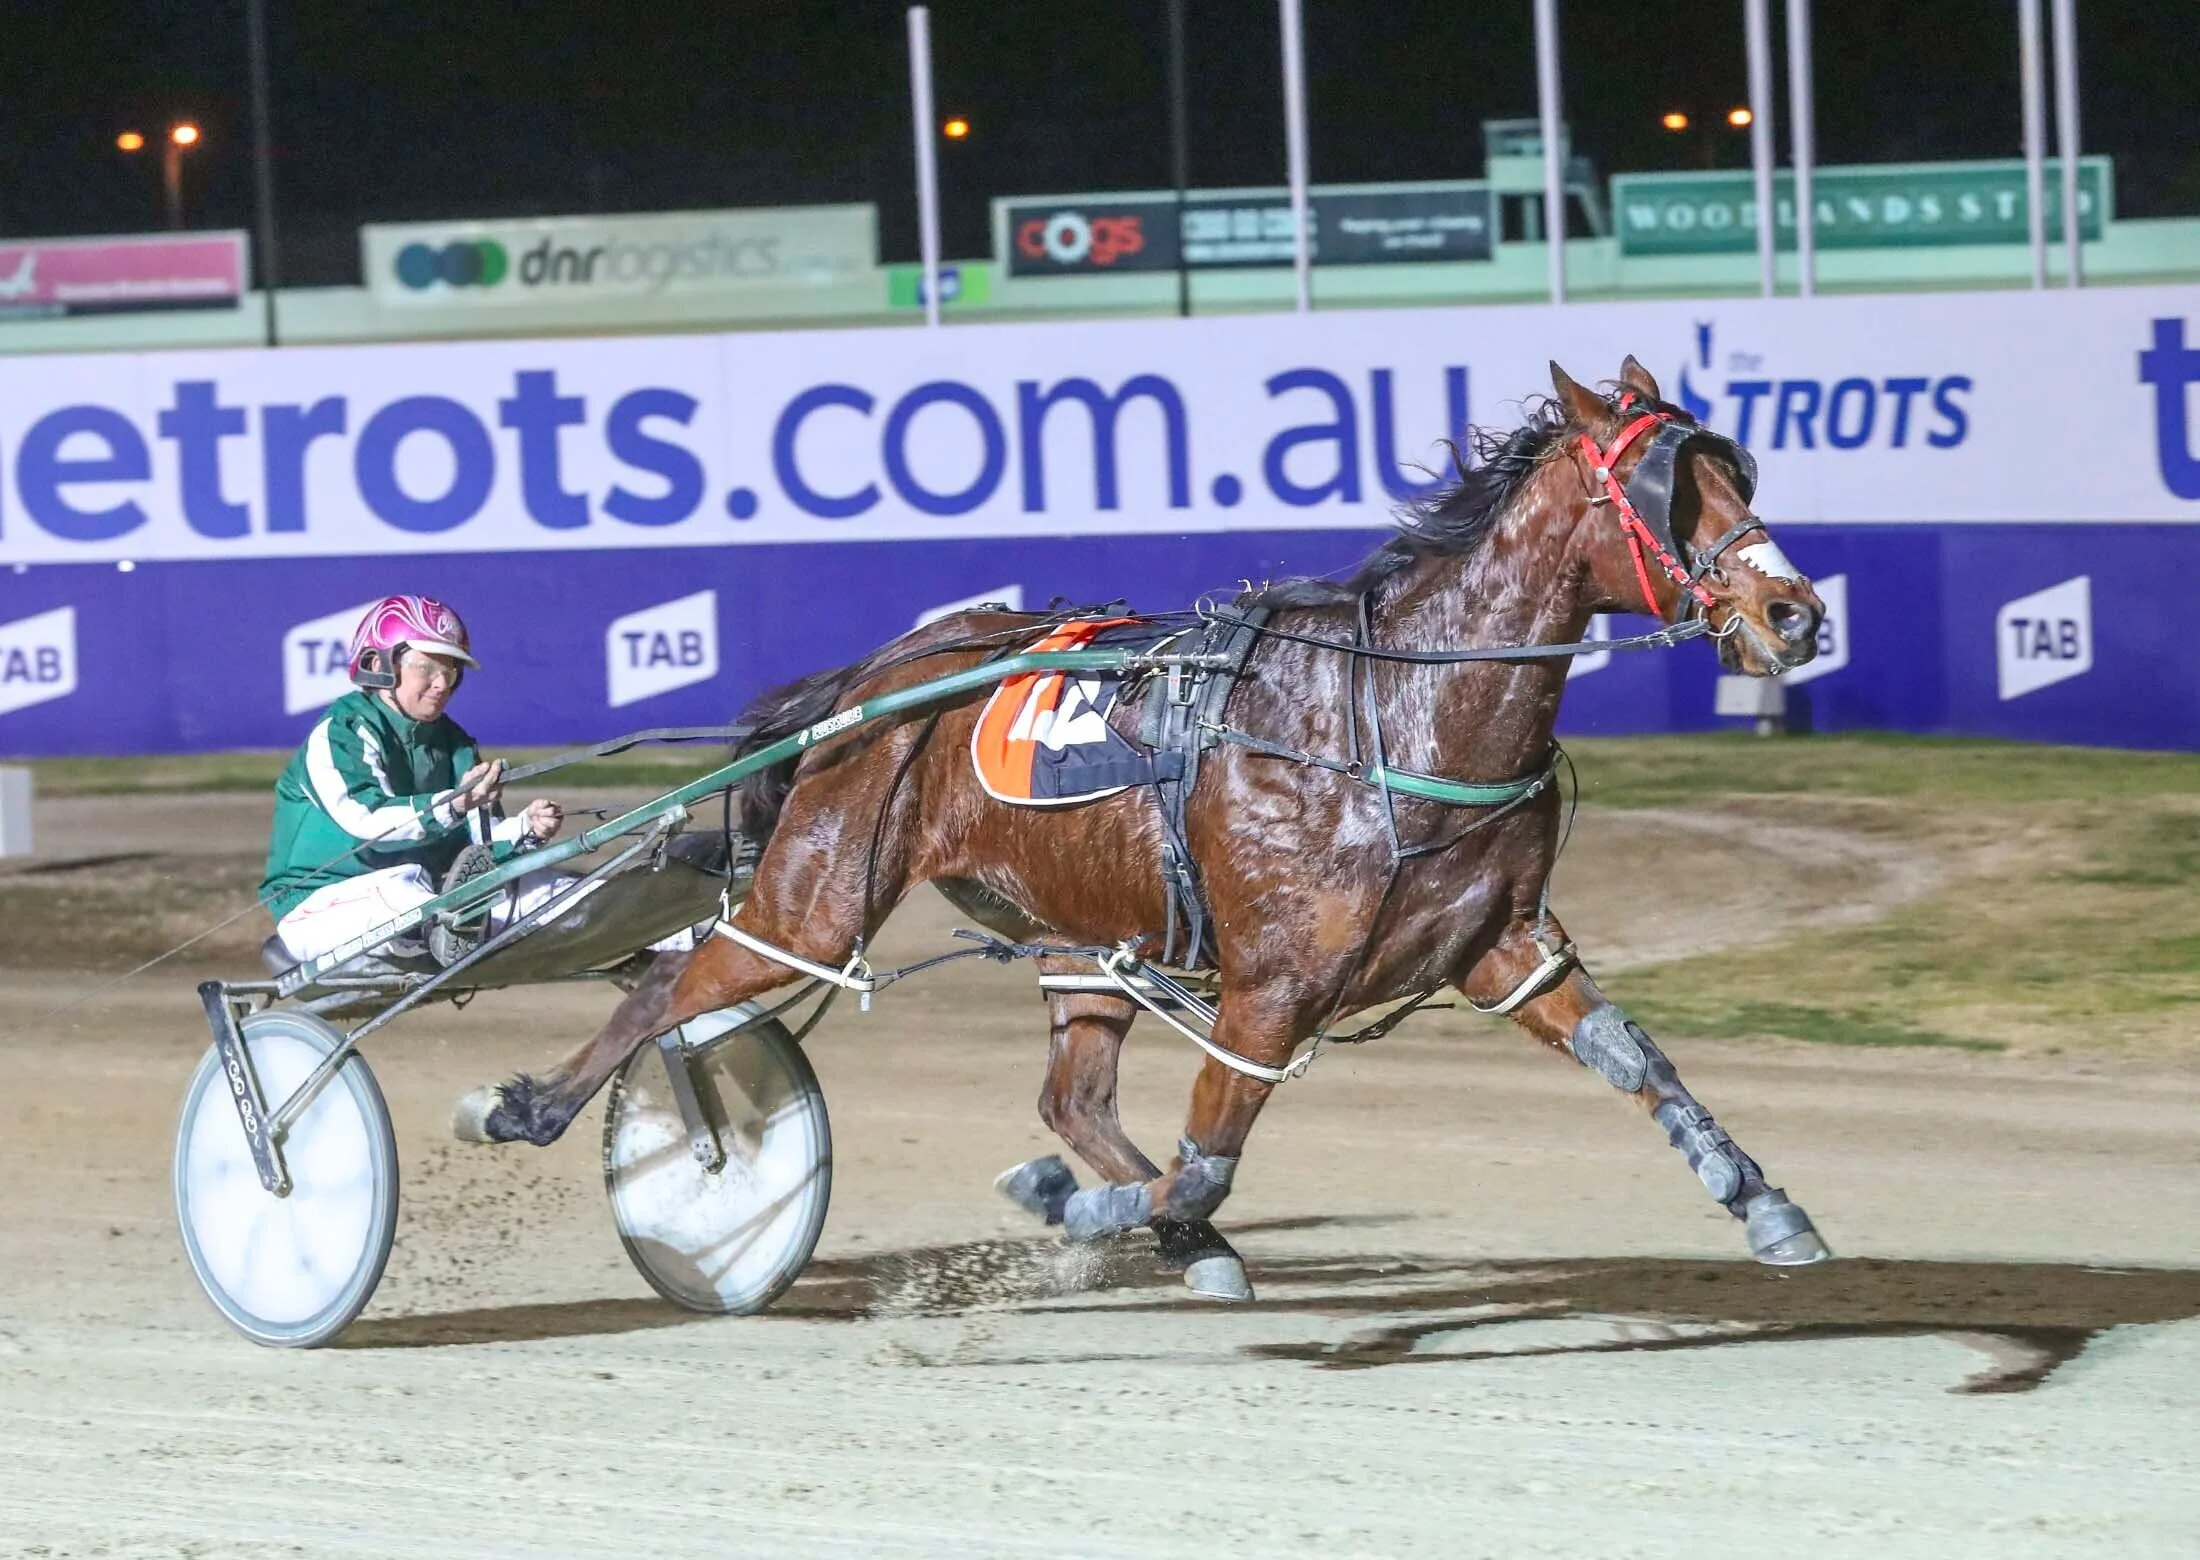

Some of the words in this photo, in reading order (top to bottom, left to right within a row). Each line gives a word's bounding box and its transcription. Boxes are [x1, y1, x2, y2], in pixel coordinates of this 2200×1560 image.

[1017, 213, 1144, 265] cogs
[1725, 375, 1974, 449] TROTS
[0, 364, 1467, 543] etrots.com.au
[299, 640, 350, 675] TA
[621, 630, 703, 668] TAB
[2009, 618, 2078, 660] TAB
